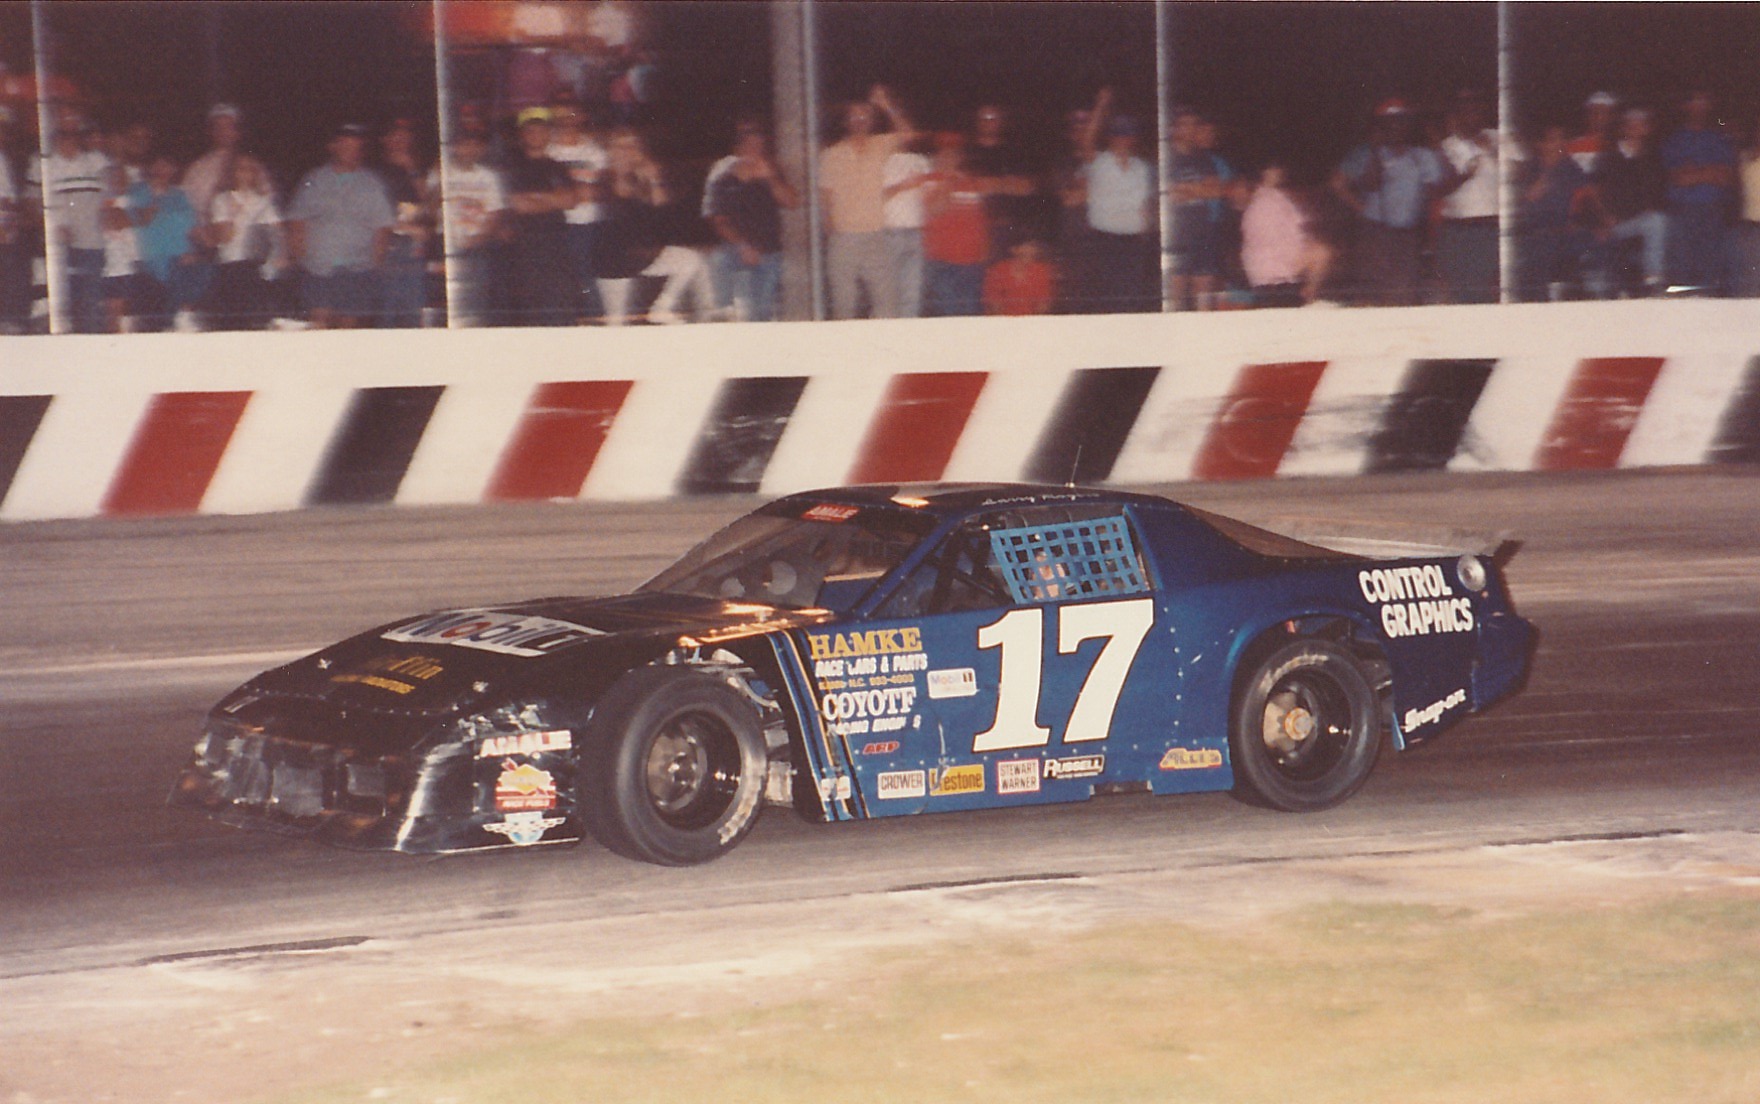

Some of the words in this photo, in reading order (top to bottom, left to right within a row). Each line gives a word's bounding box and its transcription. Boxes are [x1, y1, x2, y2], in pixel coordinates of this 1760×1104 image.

[1358, 565, 1453, 604] CONTROL
[1381, 597, 1474, 639] GRAPHICS
[808, 627, 923, 660] HAMKE
[815, 659, 844, 677] RACE
[880, 655, 890, 673] &
[893, 653, 928, 672] PARTS
[972, 598, 1156, 753] 17
[881, 773, 923, 790] CROWER
[1000, 762, 1038, 777] STEWART
[1001, 775, 1038, 790] WARNER
